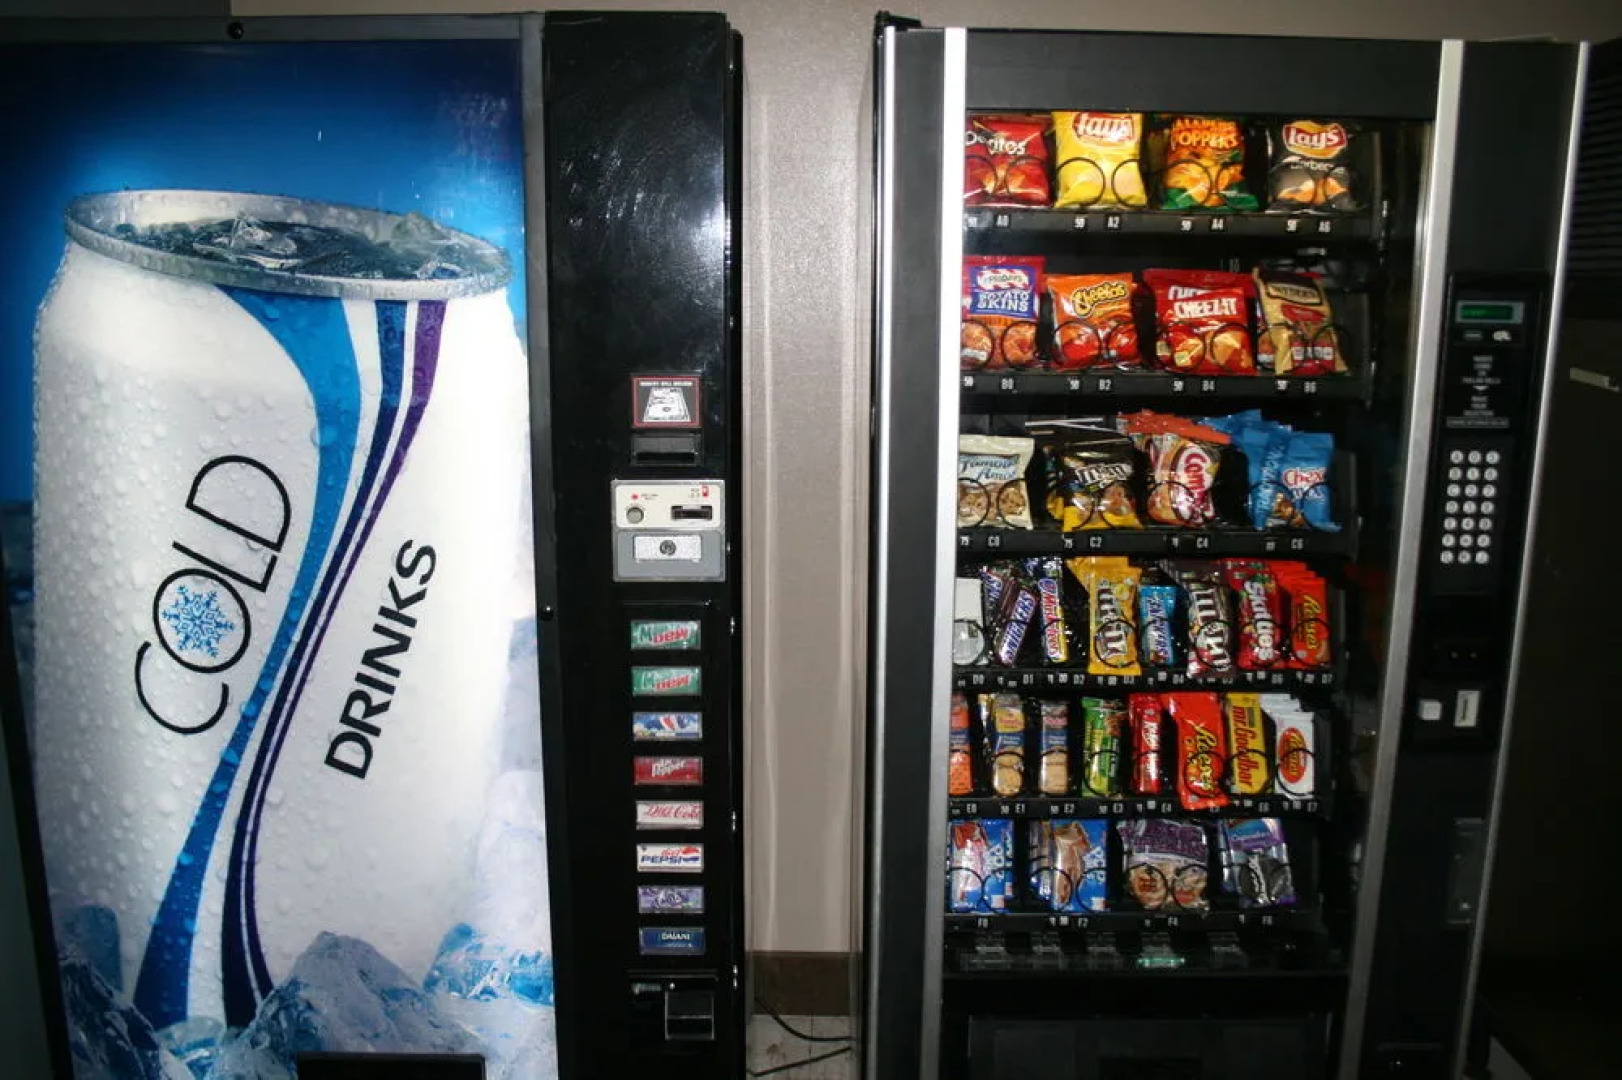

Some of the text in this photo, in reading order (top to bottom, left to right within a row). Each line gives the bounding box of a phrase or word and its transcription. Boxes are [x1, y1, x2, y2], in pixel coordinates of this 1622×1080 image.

[1072, 282, 1128, 317] Cheetos
[1282, 466, 1326, 489] Chex
[134, 455, 292, 735] COLD
[323, 538, 438, 780] DRINKS
[640, 855, 683, 865] PEPSI
